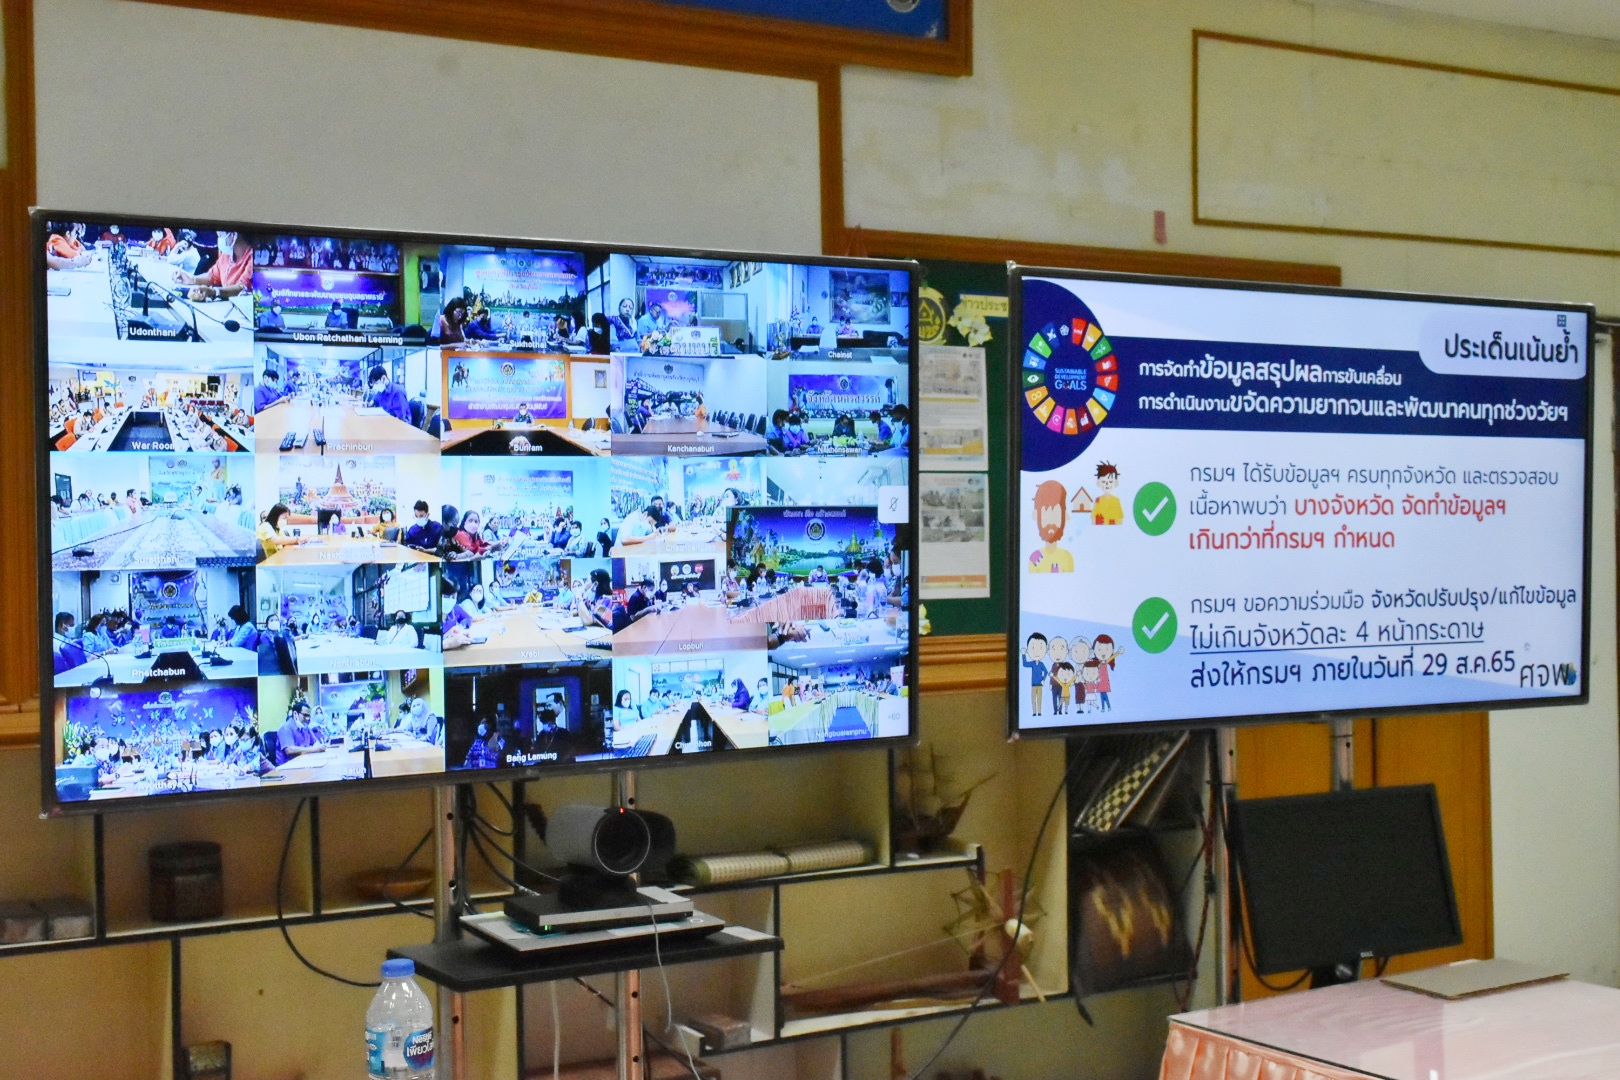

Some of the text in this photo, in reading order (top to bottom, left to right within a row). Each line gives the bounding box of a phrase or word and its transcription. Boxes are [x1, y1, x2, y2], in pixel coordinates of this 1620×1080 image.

[129, 326, 176, 338] Udonthani
[293, 332, 404, 345] Ubon Ratchathani Learning
[1444, 329, 1578, 364] ประเด็นเน้นย้ำ
[1138, 353, 1402, 388] การจัดทำข้อมูลสรุปผลการขับเคลื่อน
[1138, 390, 1568, 426] การดำเนินงานขจัดความยากจนและพัฒนาคนทุกช่วงวัยฯ
[131, 442, 150, 450] War
[1190, 463, 1559, 489] กรมฯ ได้รับข้อมูลฯ ครบทุกจังหวัด และตรวจสอบ
[1190, 489, 1506, 522] เนื้อหาพบว่า บางจังหวัด จัดทำข้อมูลฯ
[1189, 520, 1395, 549] เกินกว่าที่กรมฯ กำหนด
[1191, 584, 1577, 613] กรมฯ ขอความร่วมมือ จังหวัดปรับปรุง/แก้ไขข้อมูล
[1189, 617, 1484, 649] ไม่เกินจังหวัดละ 4 หน้ากระดาษ
[520, 650, 540, 658] Krabi
[1190, 646, 1516, 688] ส่งให้กรมฯ ภายในวันที่ 29 ส.ค.65
[506, 751, 557, 763] Bang Lamung
